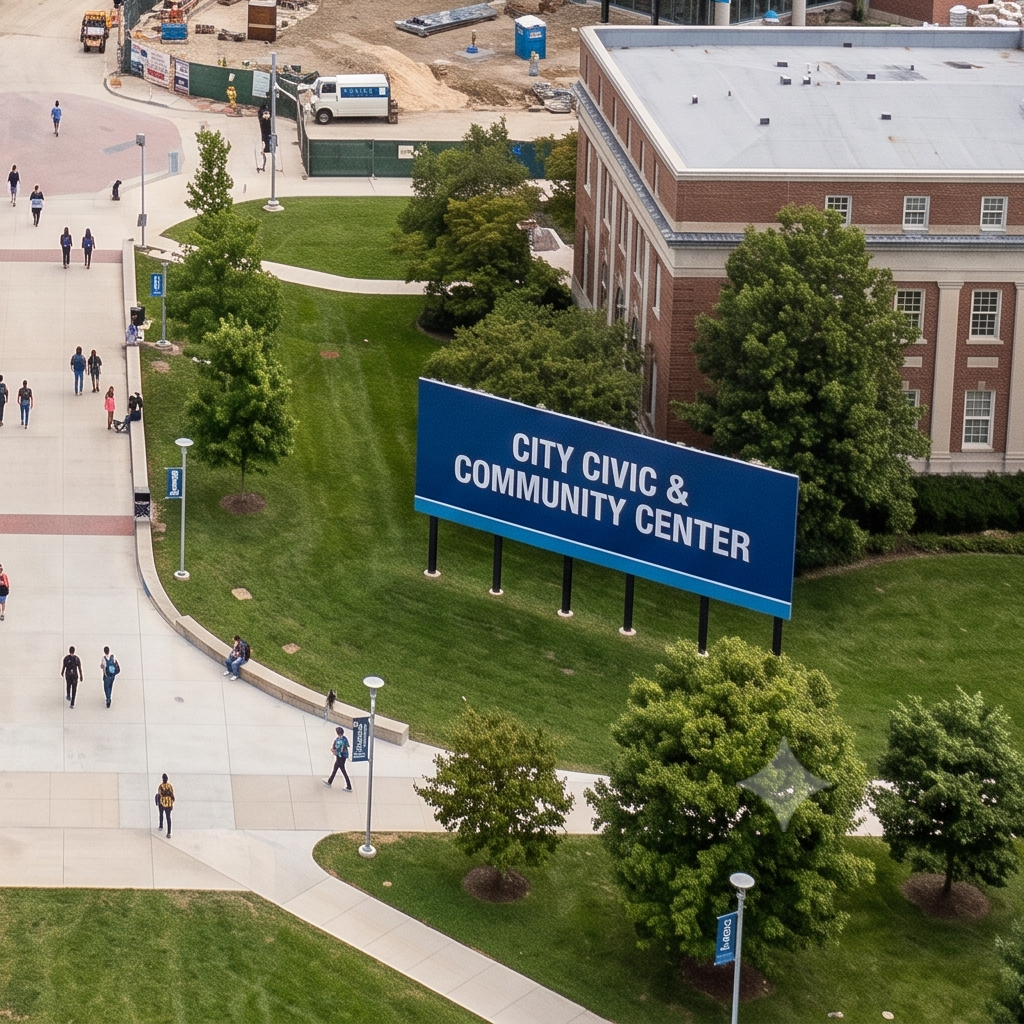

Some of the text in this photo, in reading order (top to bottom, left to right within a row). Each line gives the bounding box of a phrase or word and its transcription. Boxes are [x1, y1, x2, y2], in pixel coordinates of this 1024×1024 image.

[454, 454, 750, 563] COMMUNITY CENTER
[512, 432, 689, 507] CITY CIVIC &
